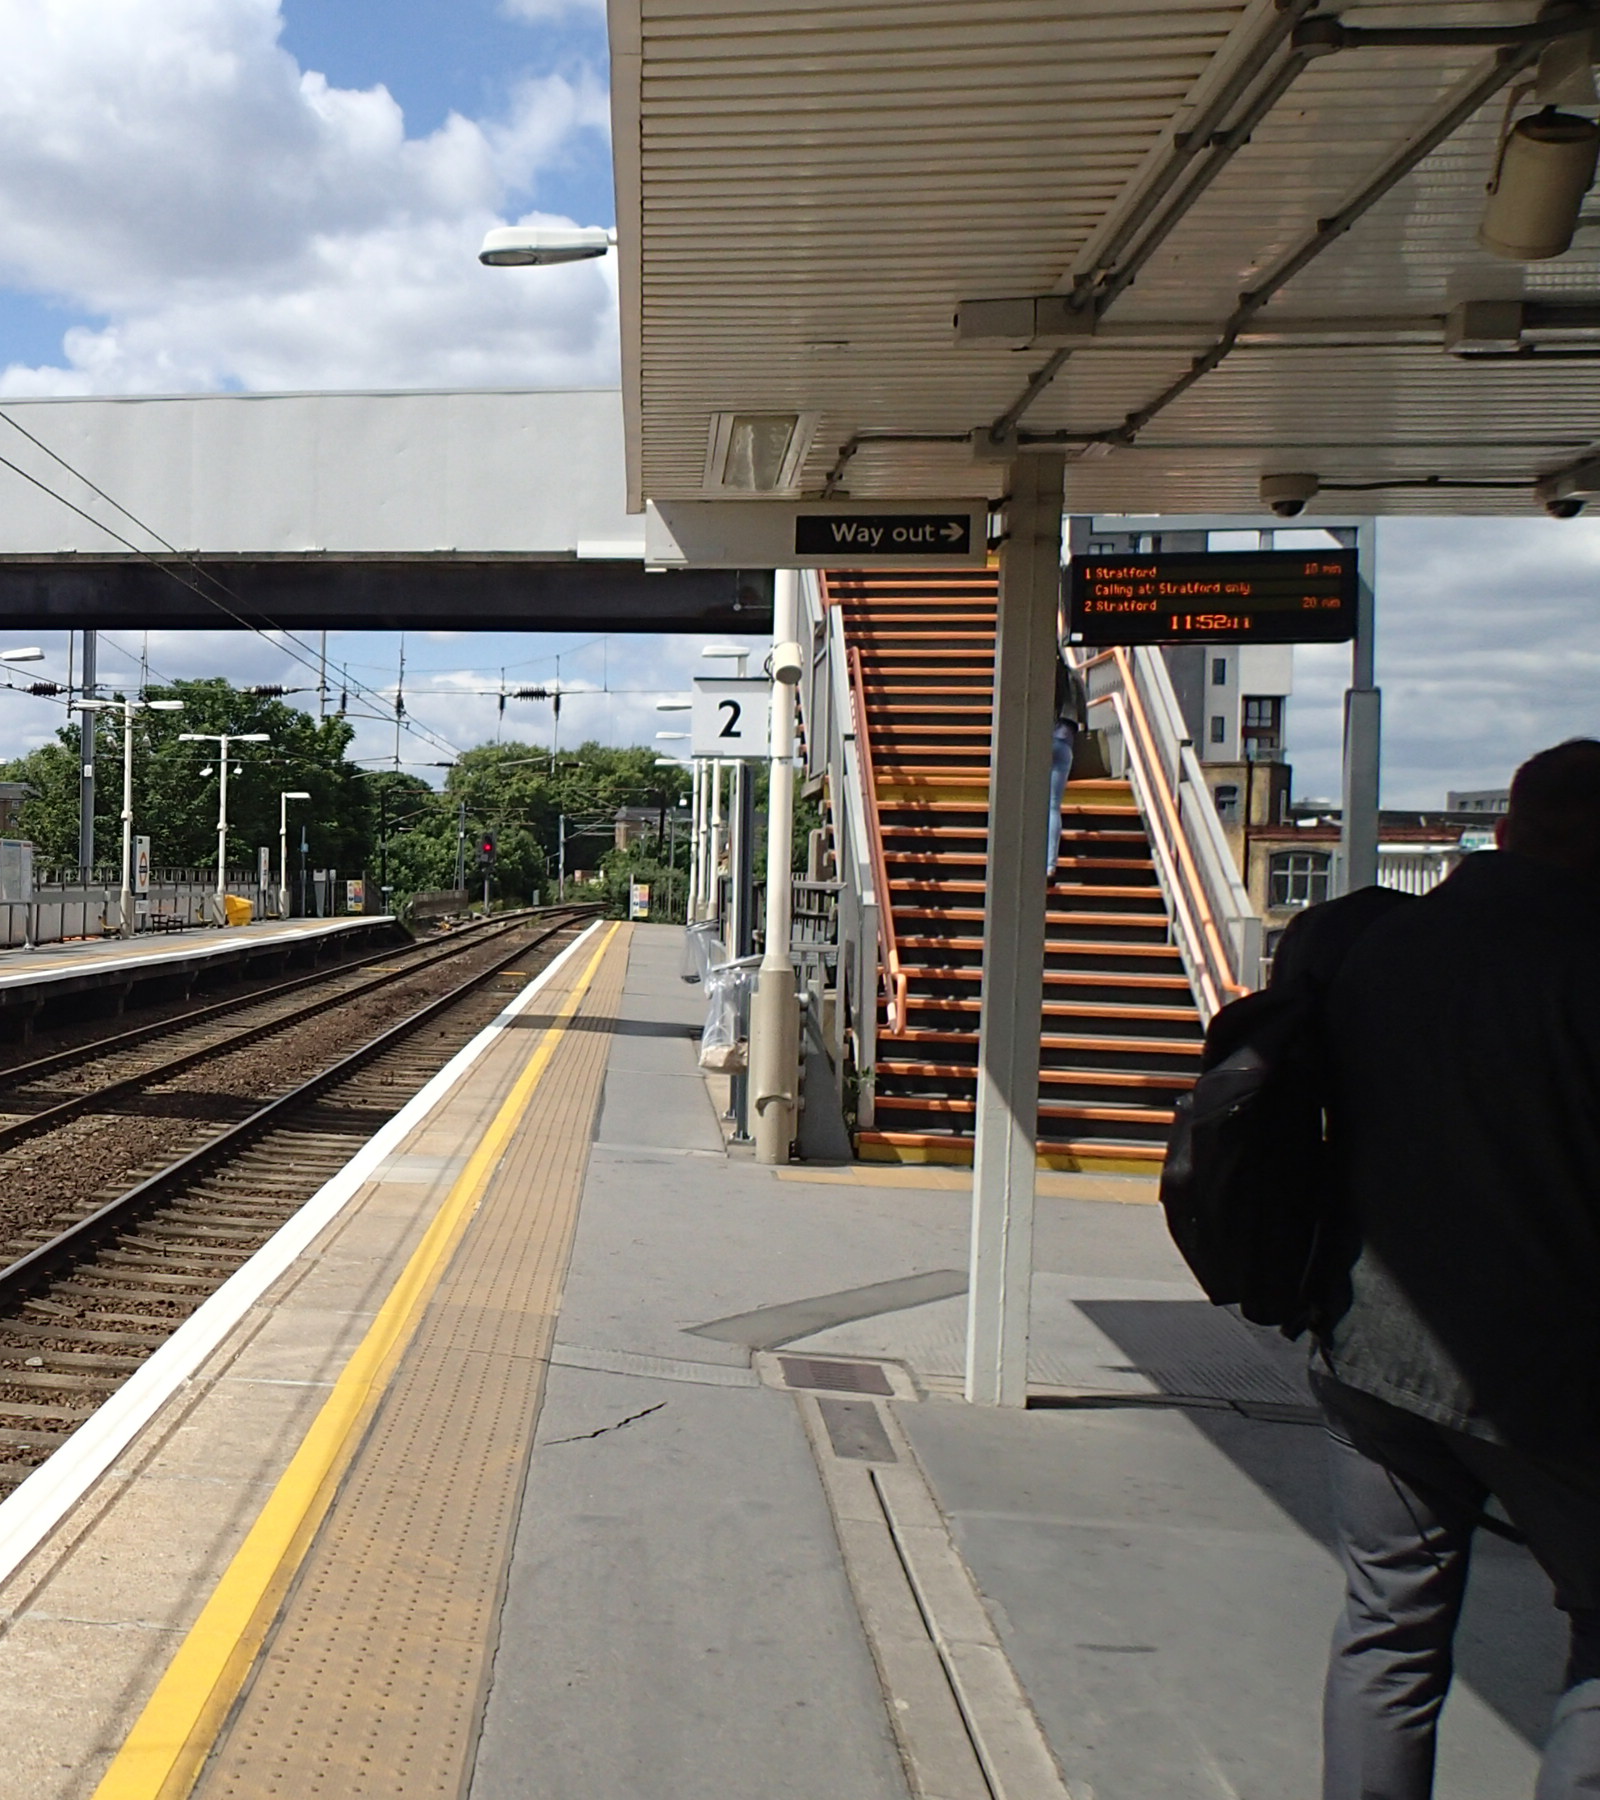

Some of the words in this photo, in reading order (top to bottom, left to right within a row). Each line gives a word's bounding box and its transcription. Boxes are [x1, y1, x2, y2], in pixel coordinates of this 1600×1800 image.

[831, 522, 883, 547] Way
[892, 524, 935, 542] out
[1085, 567, 1091, 580] 1
[1096, 566, 1157, 579] Stratford
[1322, 564, 1342, 575] min
[1095, 583, 1133, 598] Calling
[1159, 582, 1221, 595] Stratford
[1225, 582, 1251, 596] only
[1084, 600, 1092, 612] 2
[1096, 600, 1157, 612] Stratford
[1302, 596, 1317, 608] 20
[1321, 597, 1341, 608] min
[717, 699, 742, 738] 2
